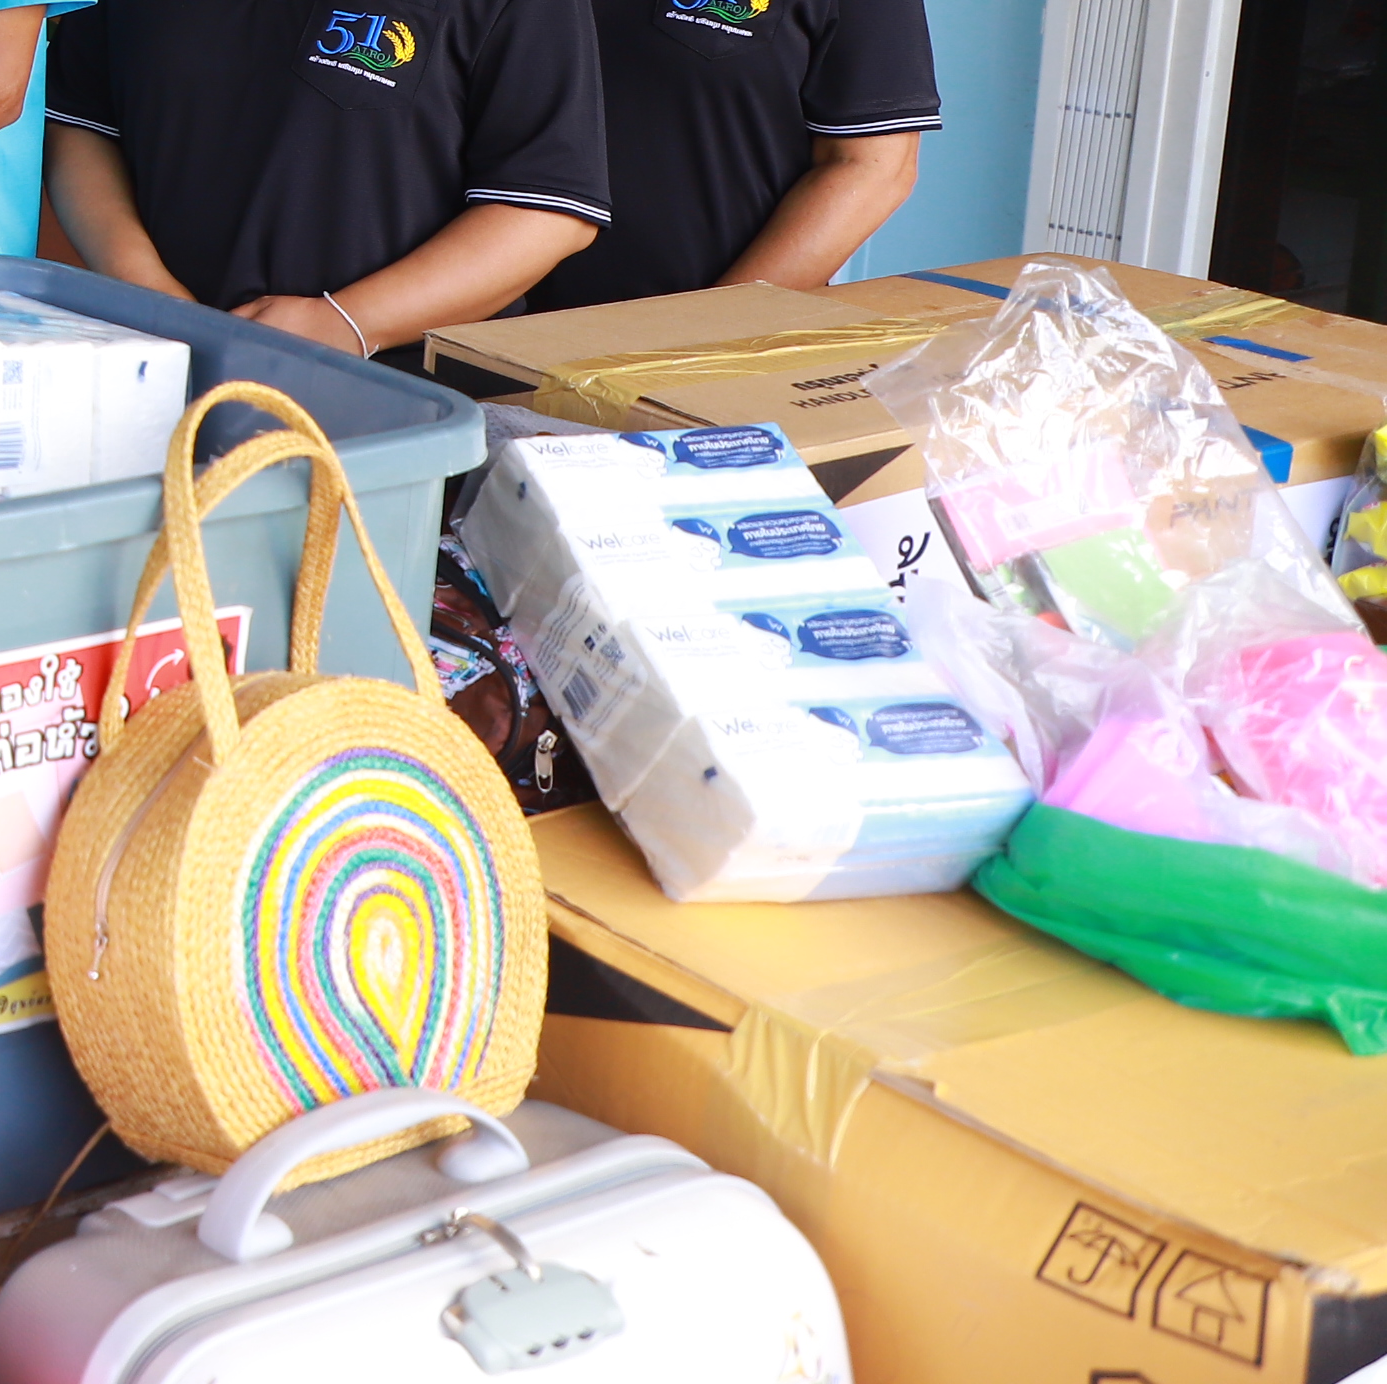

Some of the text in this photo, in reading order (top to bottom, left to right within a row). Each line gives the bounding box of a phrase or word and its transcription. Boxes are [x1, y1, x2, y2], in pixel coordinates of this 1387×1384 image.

[316, 9, 387, 55] 51
[352, 45, 386, 62] ALRO
[526, 441, 609, 457] Welcare
[576, 533, 661, 550] Welcare
[645, 626, 731, 643] Welcare
